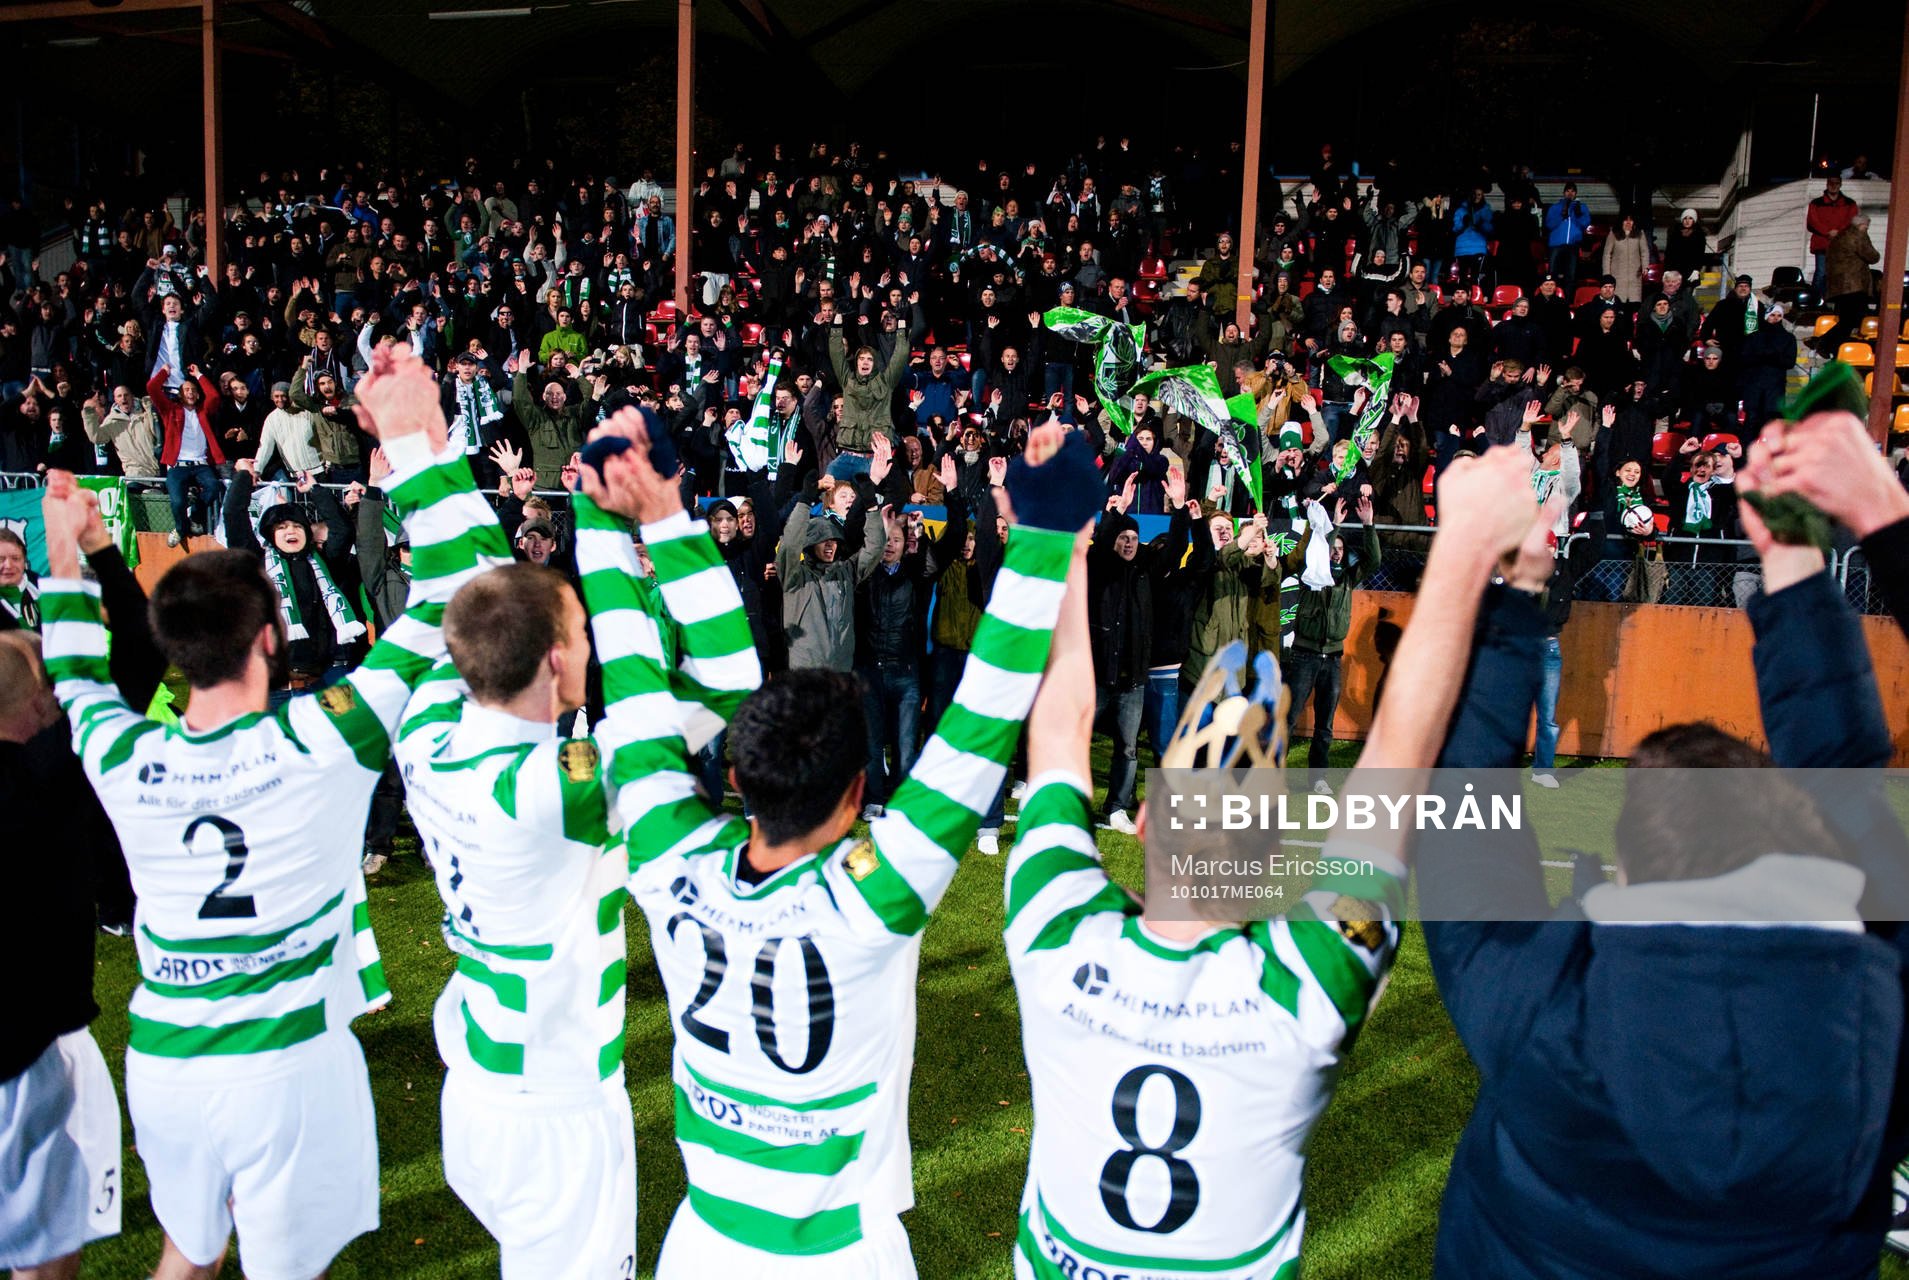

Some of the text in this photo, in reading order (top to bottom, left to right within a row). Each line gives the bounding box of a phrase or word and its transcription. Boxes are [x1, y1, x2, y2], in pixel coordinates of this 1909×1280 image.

[182, 814, 257, 919] 2
[667, 910, 835, 1075] 20
[1062, 1002, 1094, 1031] Allt
[1182, 1039, 1267, 1058] badrum
[95, 1167, 116, 1215] 5
[1099, 1063, 1202, 1234] 8
